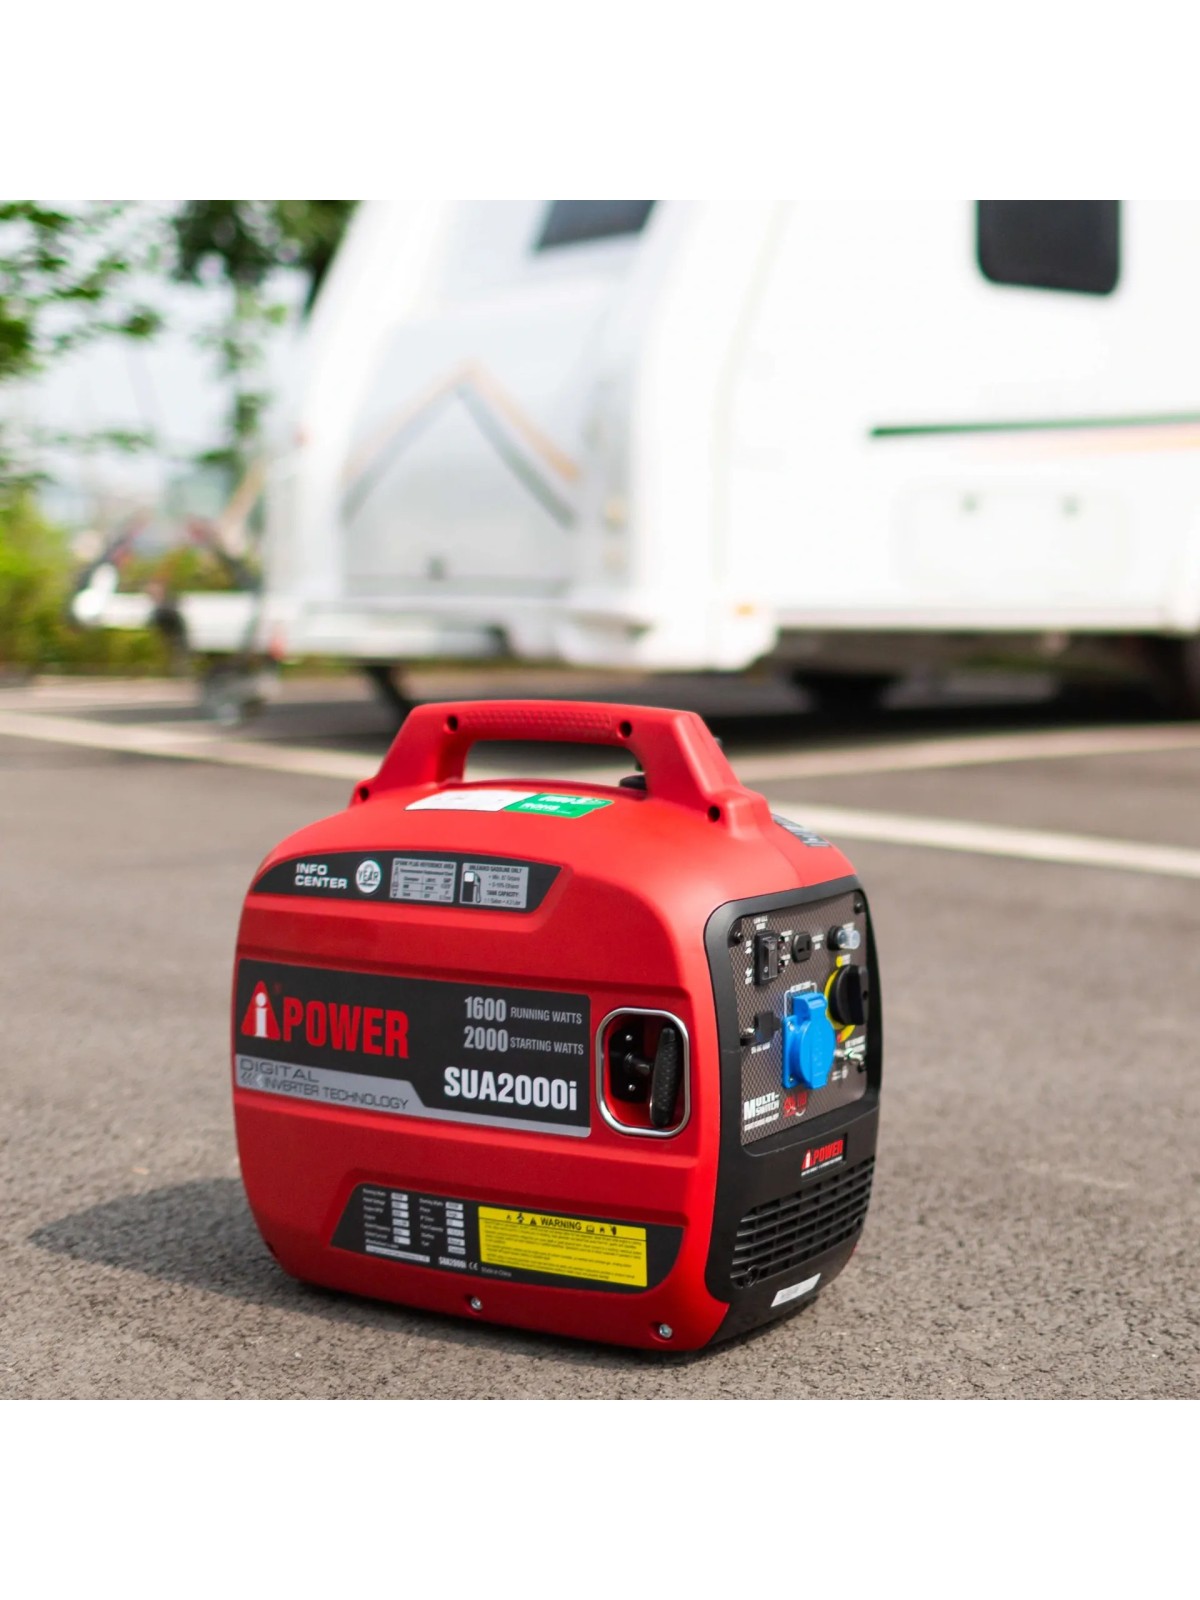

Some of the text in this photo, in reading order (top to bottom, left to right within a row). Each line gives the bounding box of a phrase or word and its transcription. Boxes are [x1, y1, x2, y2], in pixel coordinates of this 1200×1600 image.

[296, 863, 327, 875] INFO
[358, 870, 379, 882] YEAR
[295, 875, 347, 889] CENTER
[464, 996, 583, 1025] 1600 RUNNING WATTS
[463, 1025, 584, 1056] 2000 STARTING WATTS
[240, 1058, 320, 1083] DIGITAL
[264, 1077, 409, 1110] INVERTER TECHNOLOGY
[443, 1066, 577, 1111] SUA2000i
[540, 1216, 582, 1231] WARNING
